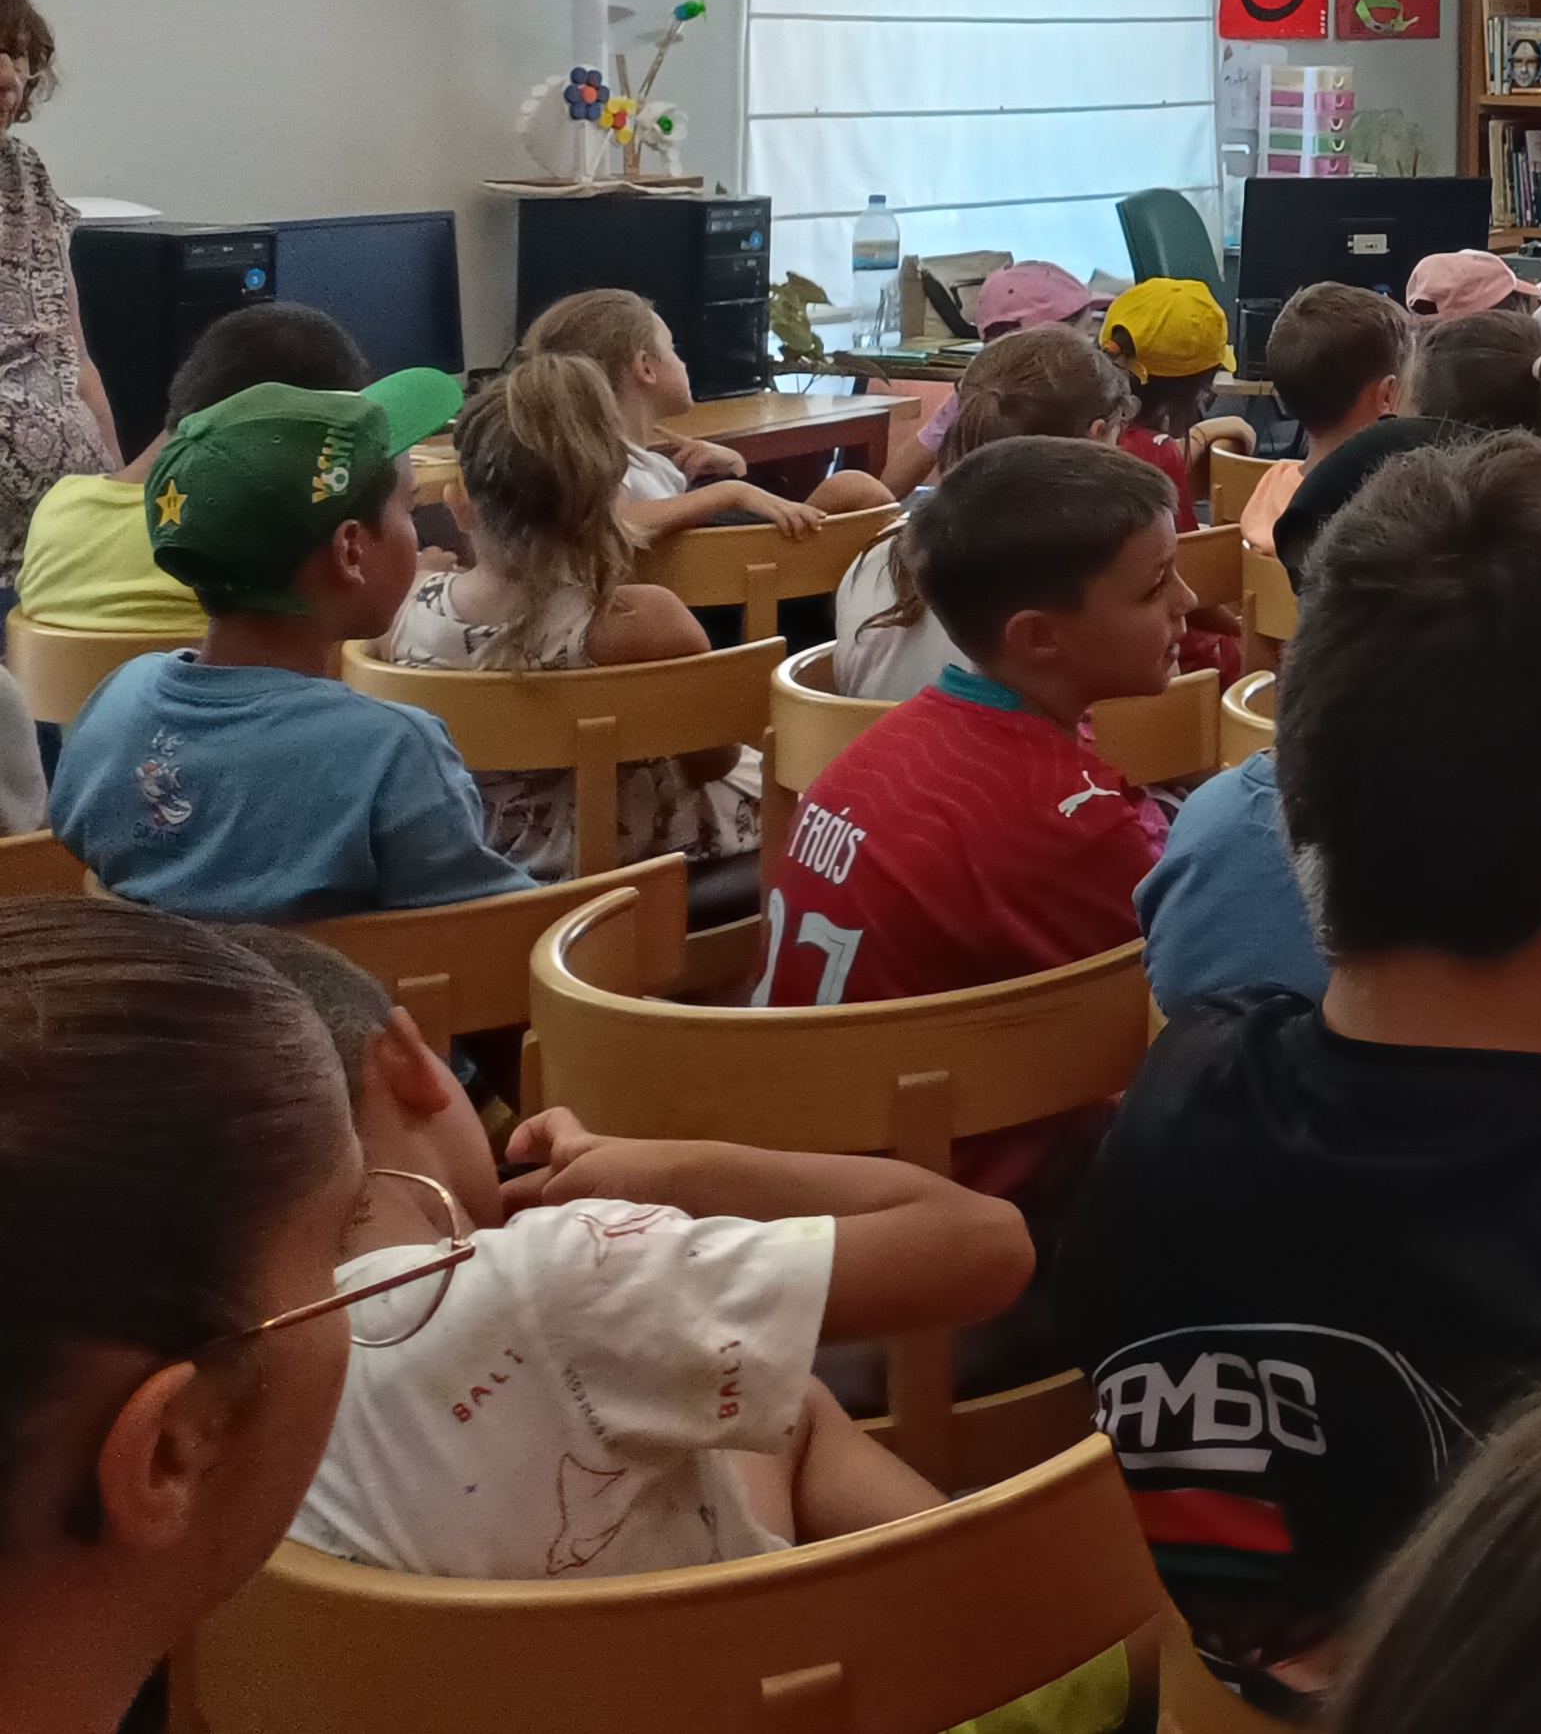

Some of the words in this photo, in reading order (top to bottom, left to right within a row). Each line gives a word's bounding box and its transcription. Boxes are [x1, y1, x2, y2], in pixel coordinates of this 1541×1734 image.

[751, 887, 864, 1008] 17
[452, 1349, 525, 1423] BALI
[717, 1340, 743, 1420] BALI
